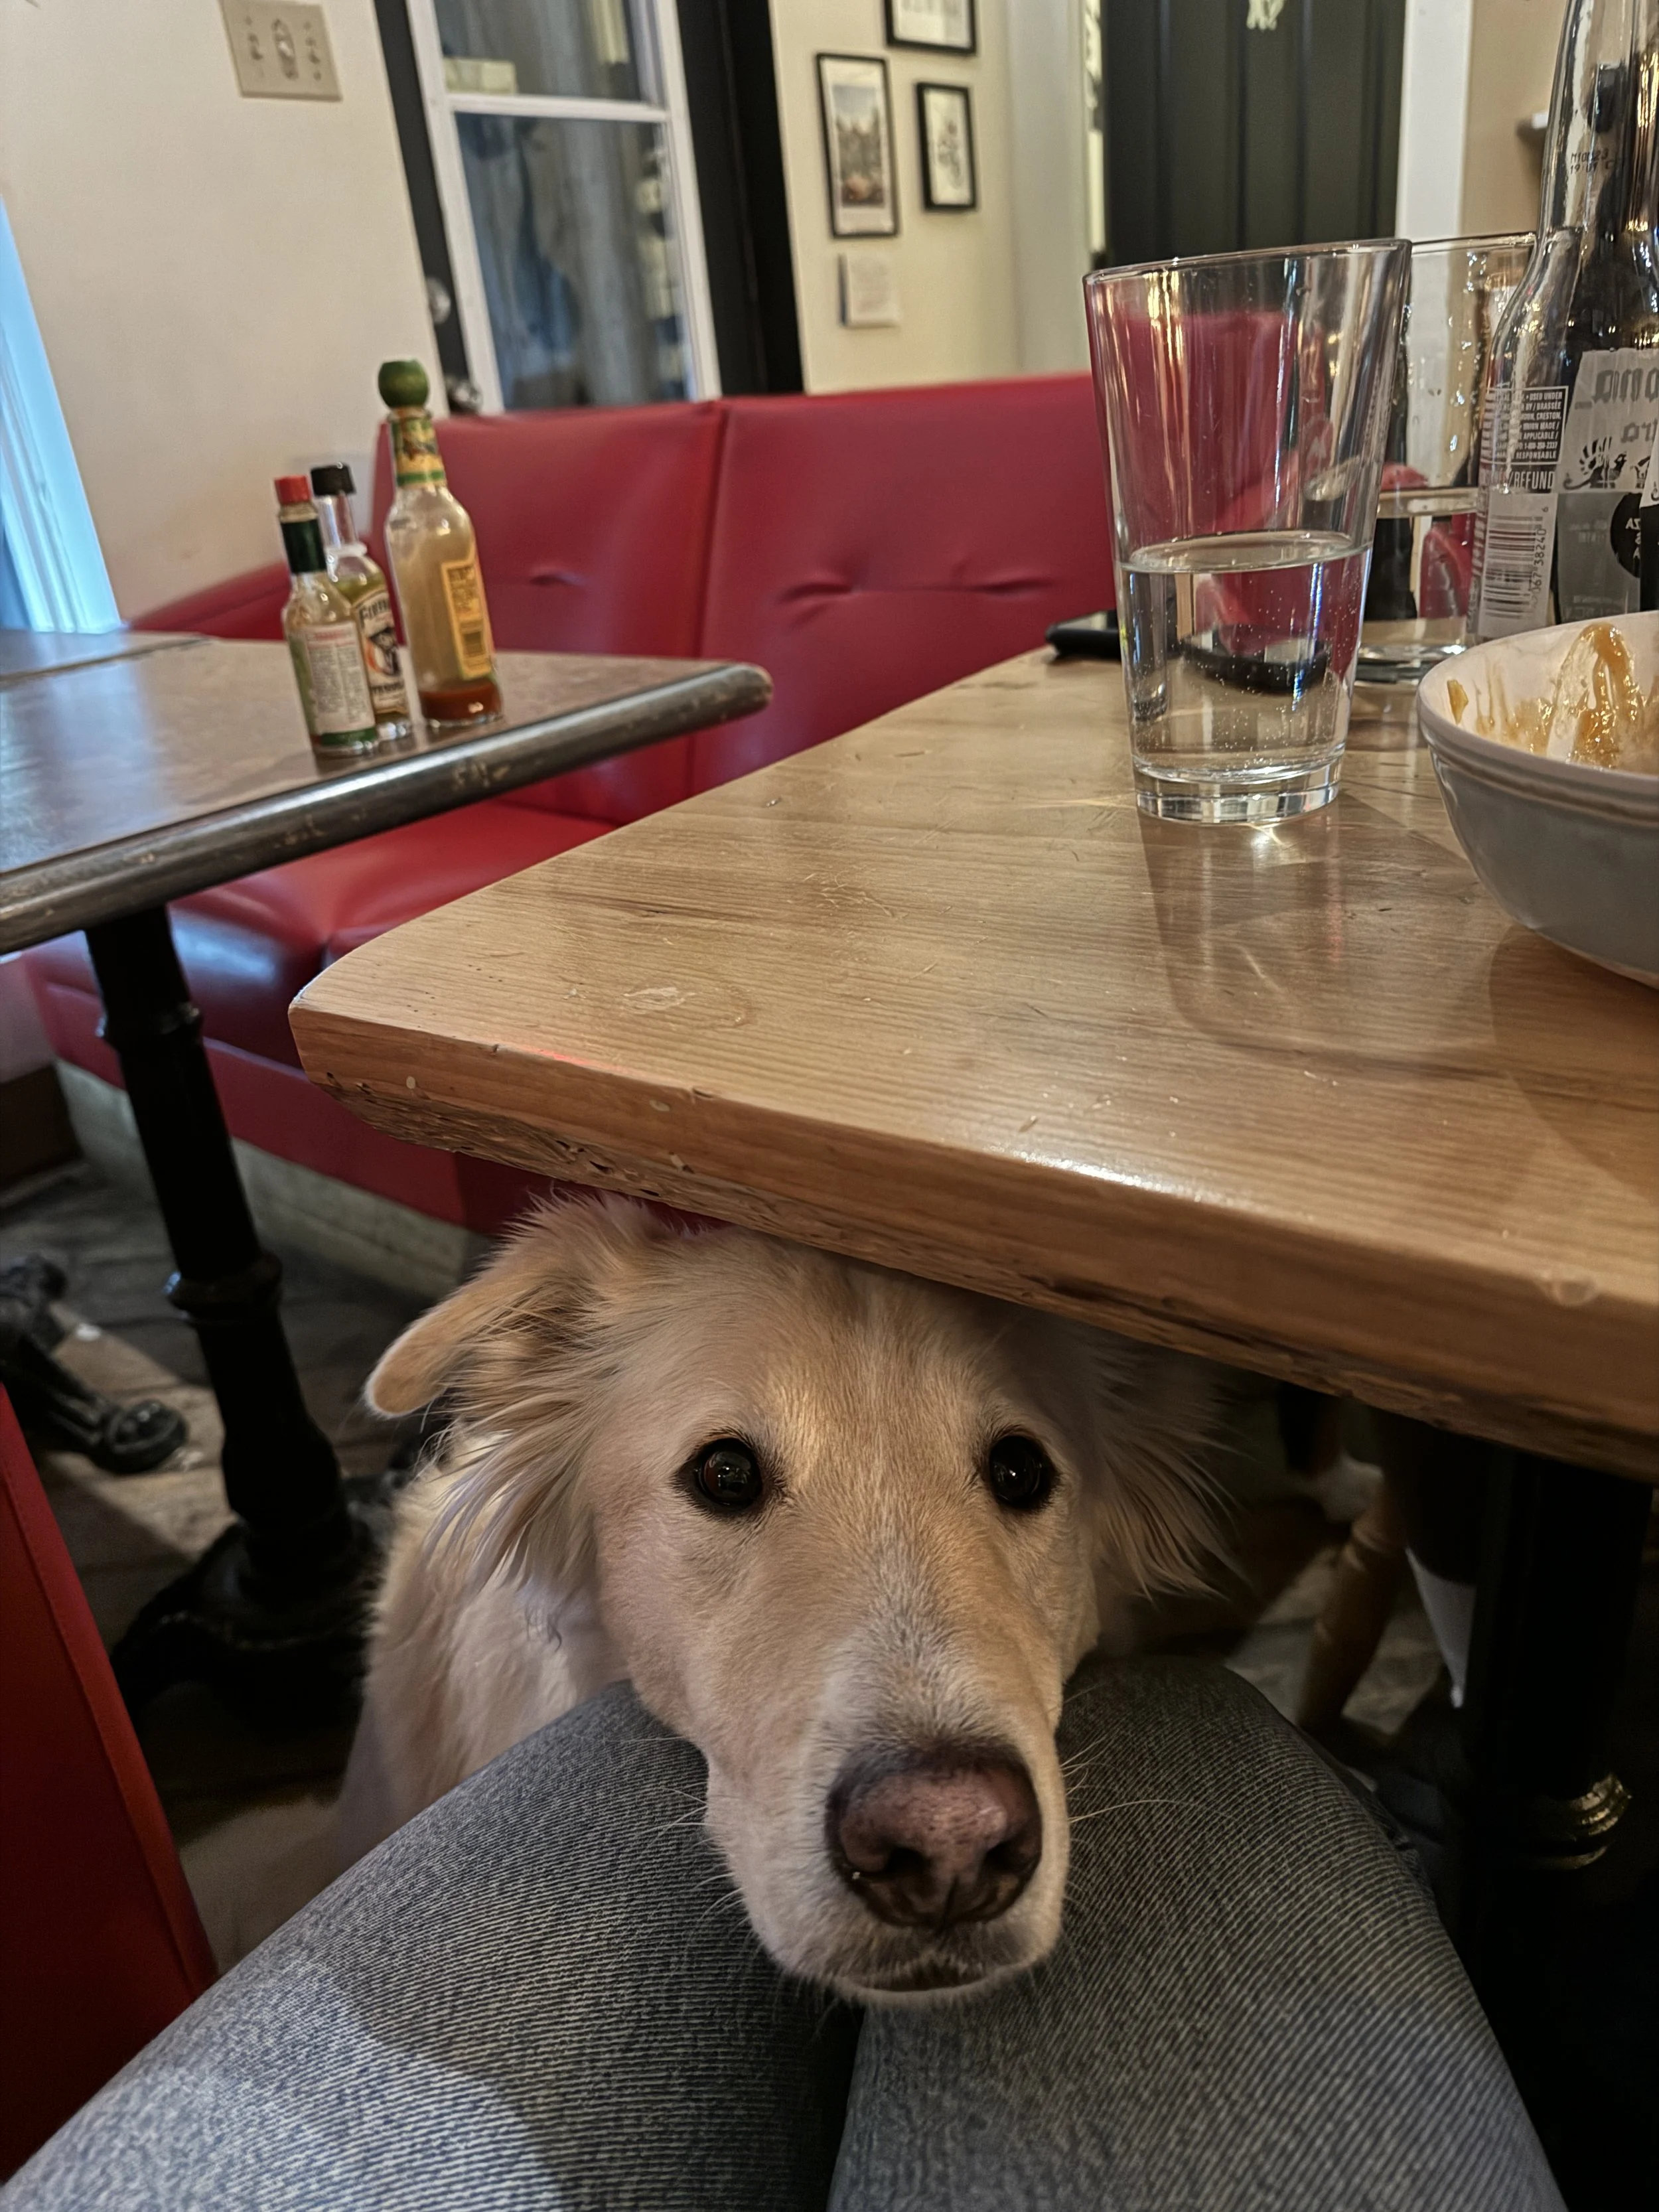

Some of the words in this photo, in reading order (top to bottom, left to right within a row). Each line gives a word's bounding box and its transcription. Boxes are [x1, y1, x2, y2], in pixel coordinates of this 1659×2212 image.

[1544, 391, 1563, 400] UNDER
[1540, 421, 1555, 430] MADE
[1523, 431, 1554, 440] APPLICABLE
[1516, 451, 1556, 459] RESPONSABLE
[1534, 529, 1547, 566] 38240
